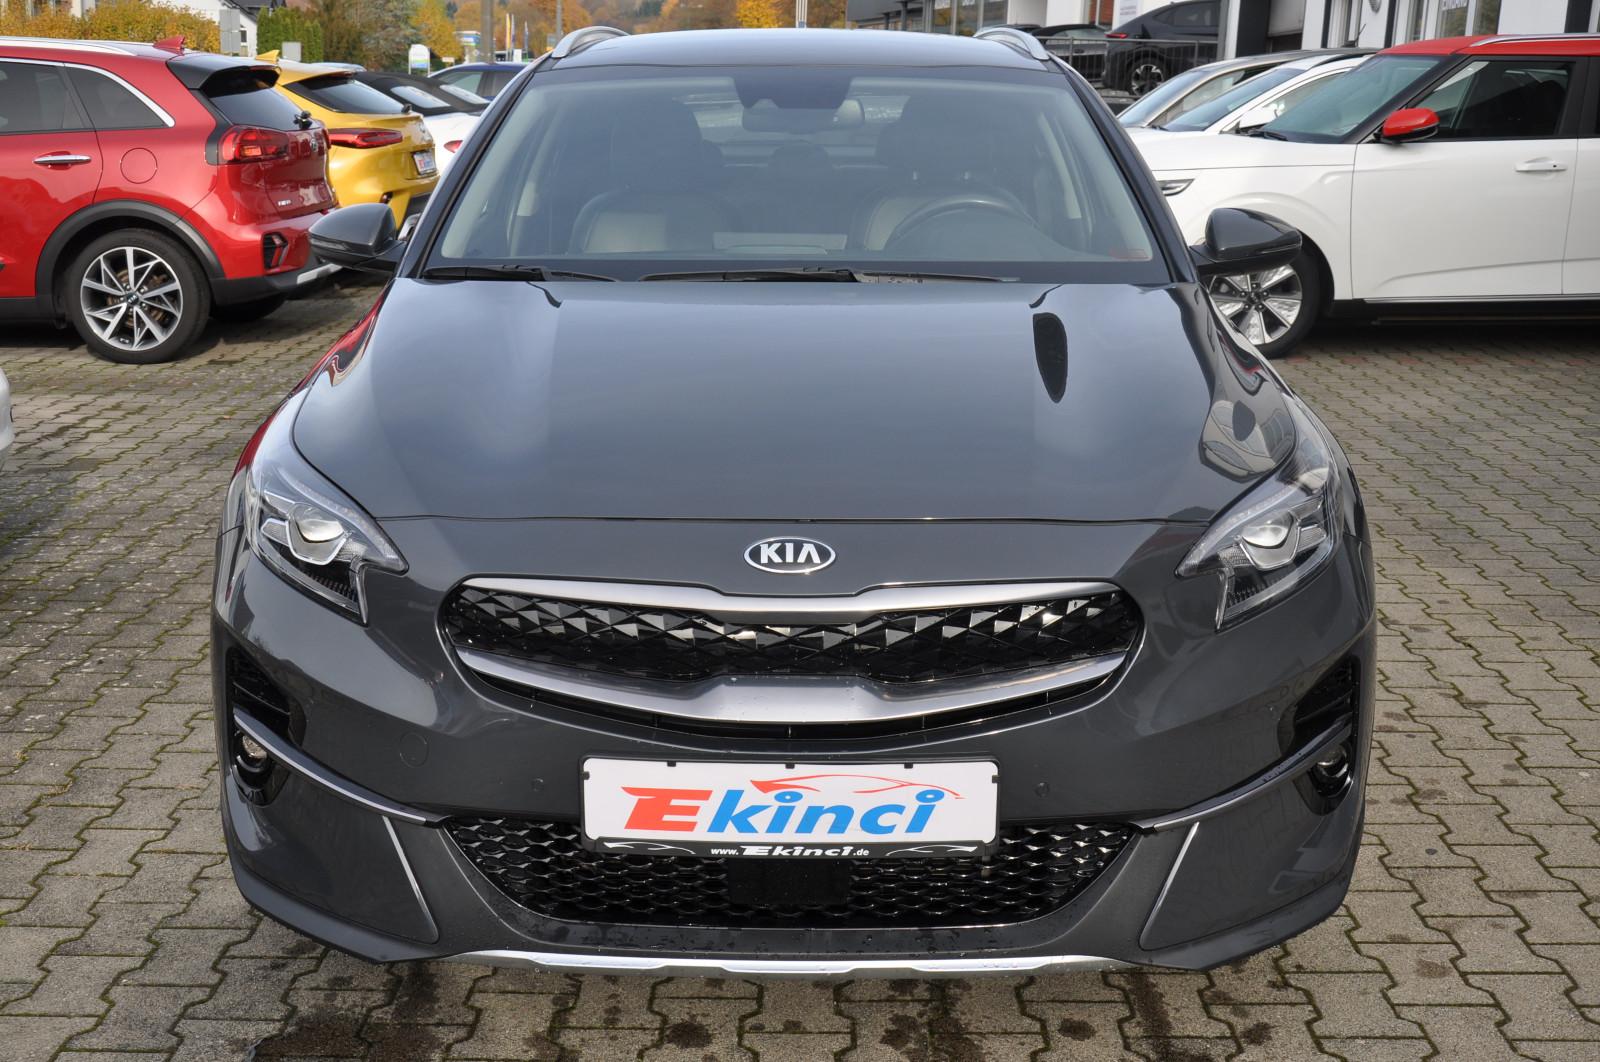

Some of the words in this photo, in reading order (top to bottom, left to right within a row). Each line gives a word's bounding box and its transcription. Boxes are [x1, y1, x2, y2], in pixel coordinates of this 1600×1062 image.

[760, 542, 821, 564] KIA
[621, 787, 945, 835] Ekinci
[711, 845, 869, 856] www.Ekinci.de
